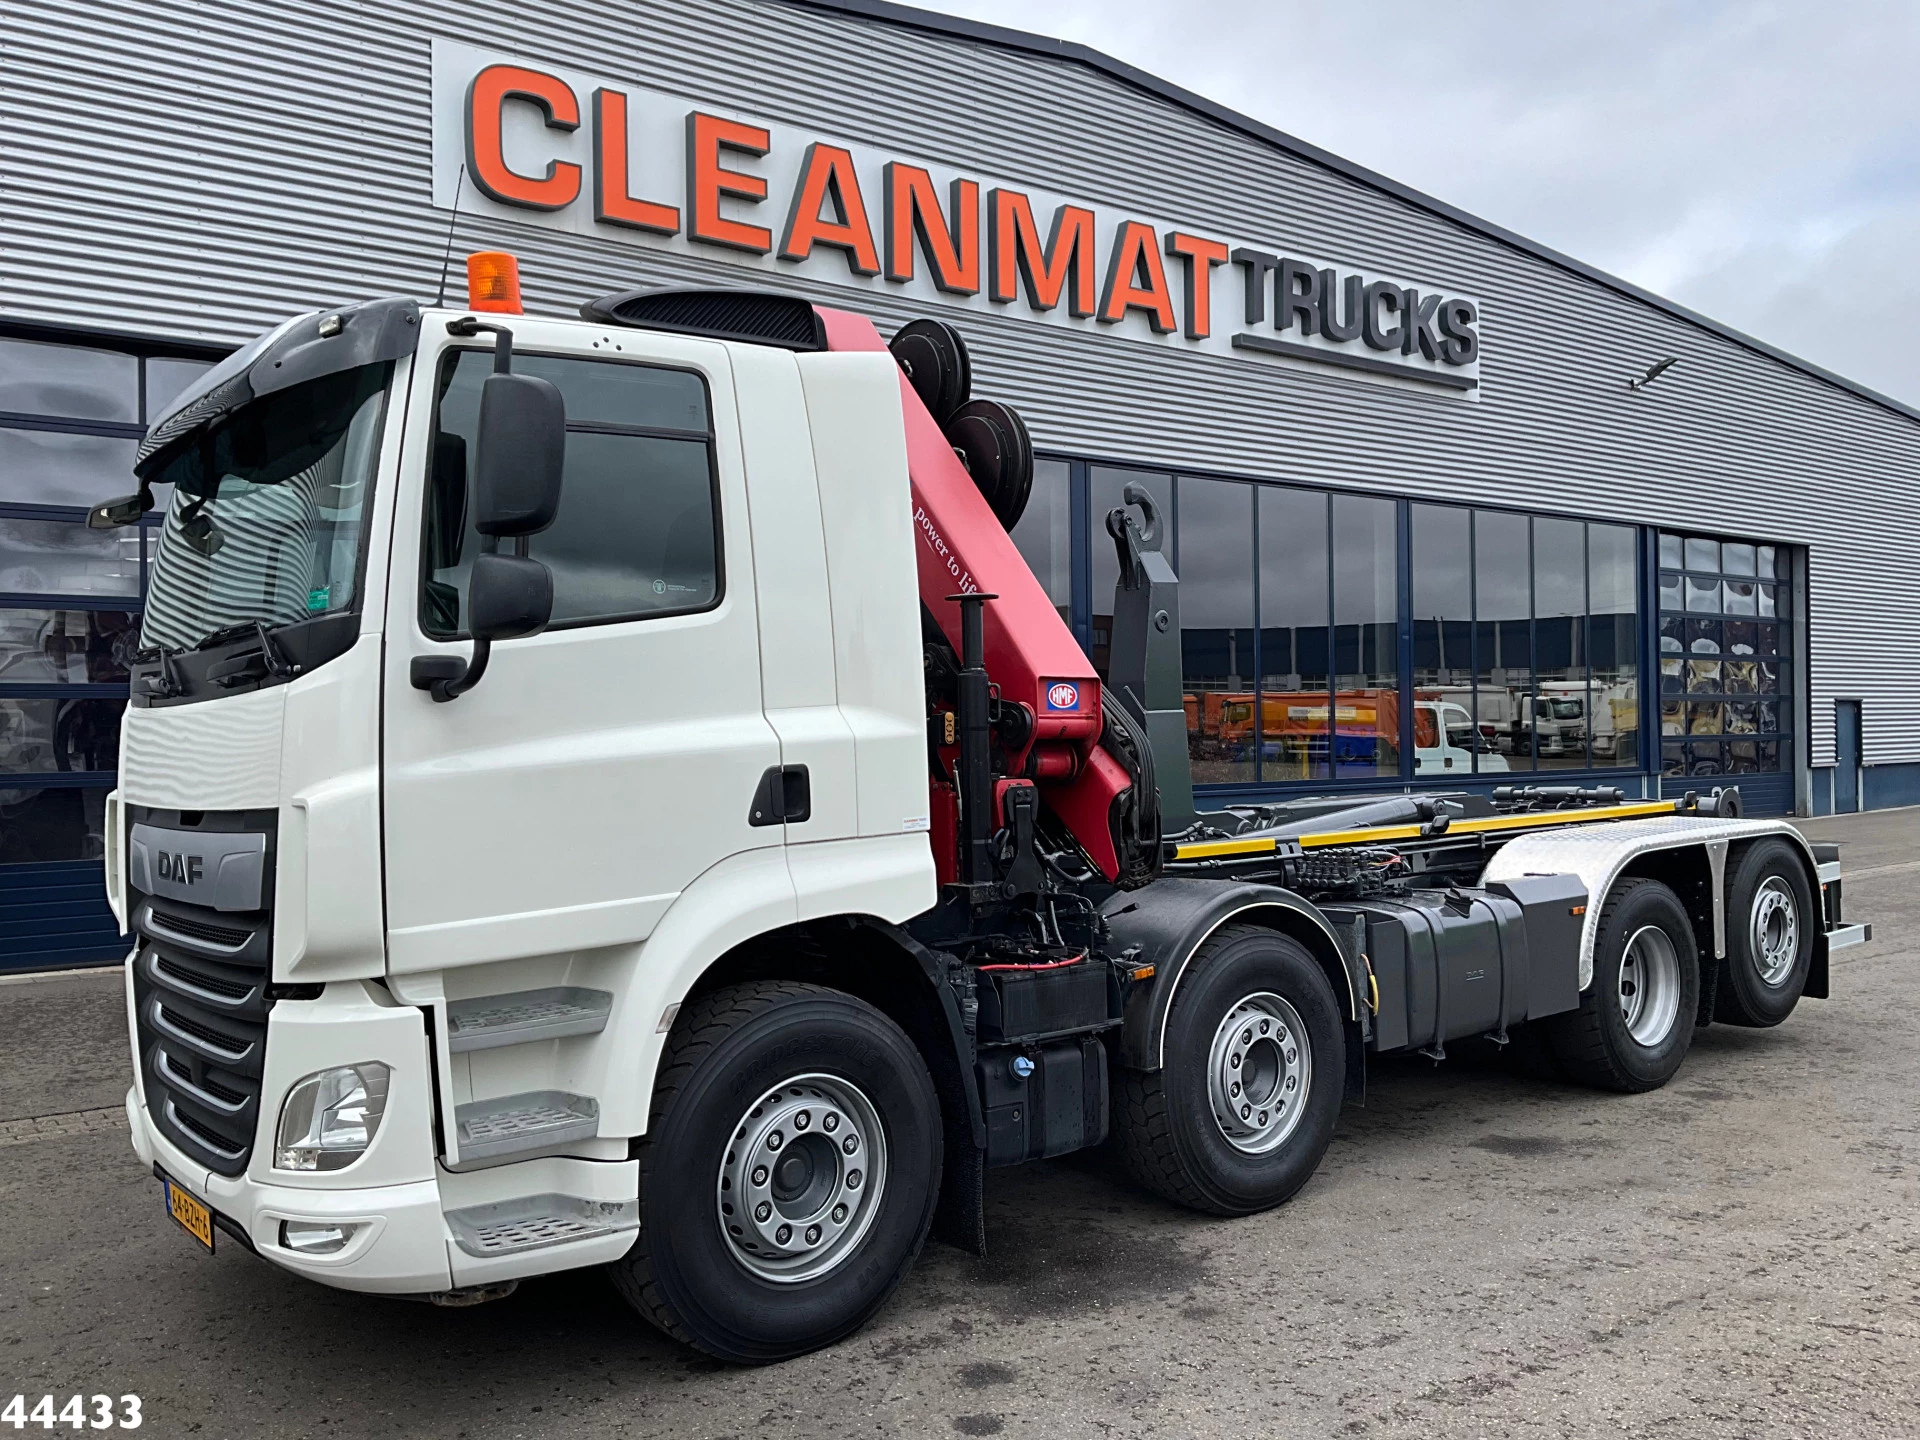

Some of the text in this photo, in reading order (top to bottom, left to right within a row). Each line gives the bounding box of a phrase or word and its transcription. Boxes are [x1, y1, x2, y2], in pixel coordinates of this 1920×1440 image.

[464, 63, 1479, 366] CLEANMAT TRUCKS
[913, 506, 977, 594] power to lif
[1052, 687, 1074, 705] HMF
[158, 850, 203, 885] DAF
[172, 1189, 209, 1240] 64-BZH-6
